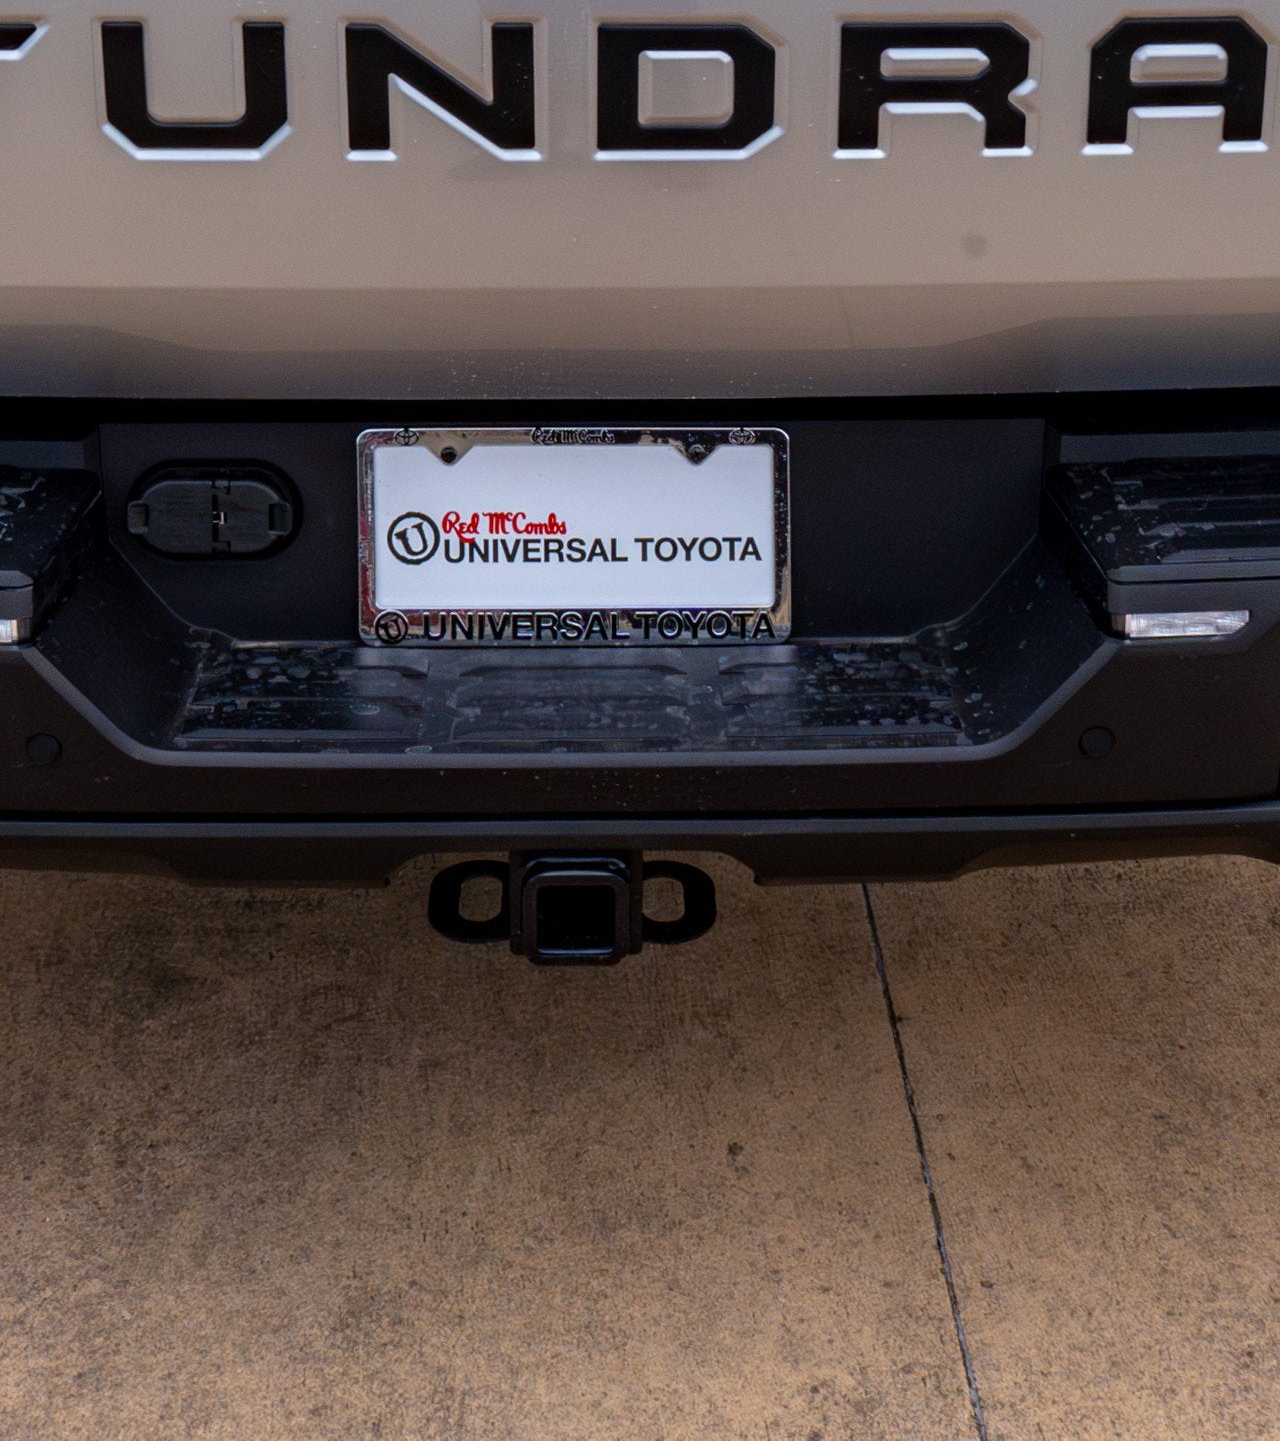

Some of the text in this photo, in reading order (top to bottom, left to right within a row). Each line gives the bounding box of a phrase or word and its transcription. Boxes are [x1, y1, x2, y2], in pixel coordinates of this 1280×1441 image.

[442, 511, 567, 543] Red McCombs
[443, 537, 762, 563] UNIVERSAL TOYOTA
[421, 611, 776, 641] UNIVERSAL TOYOTA
